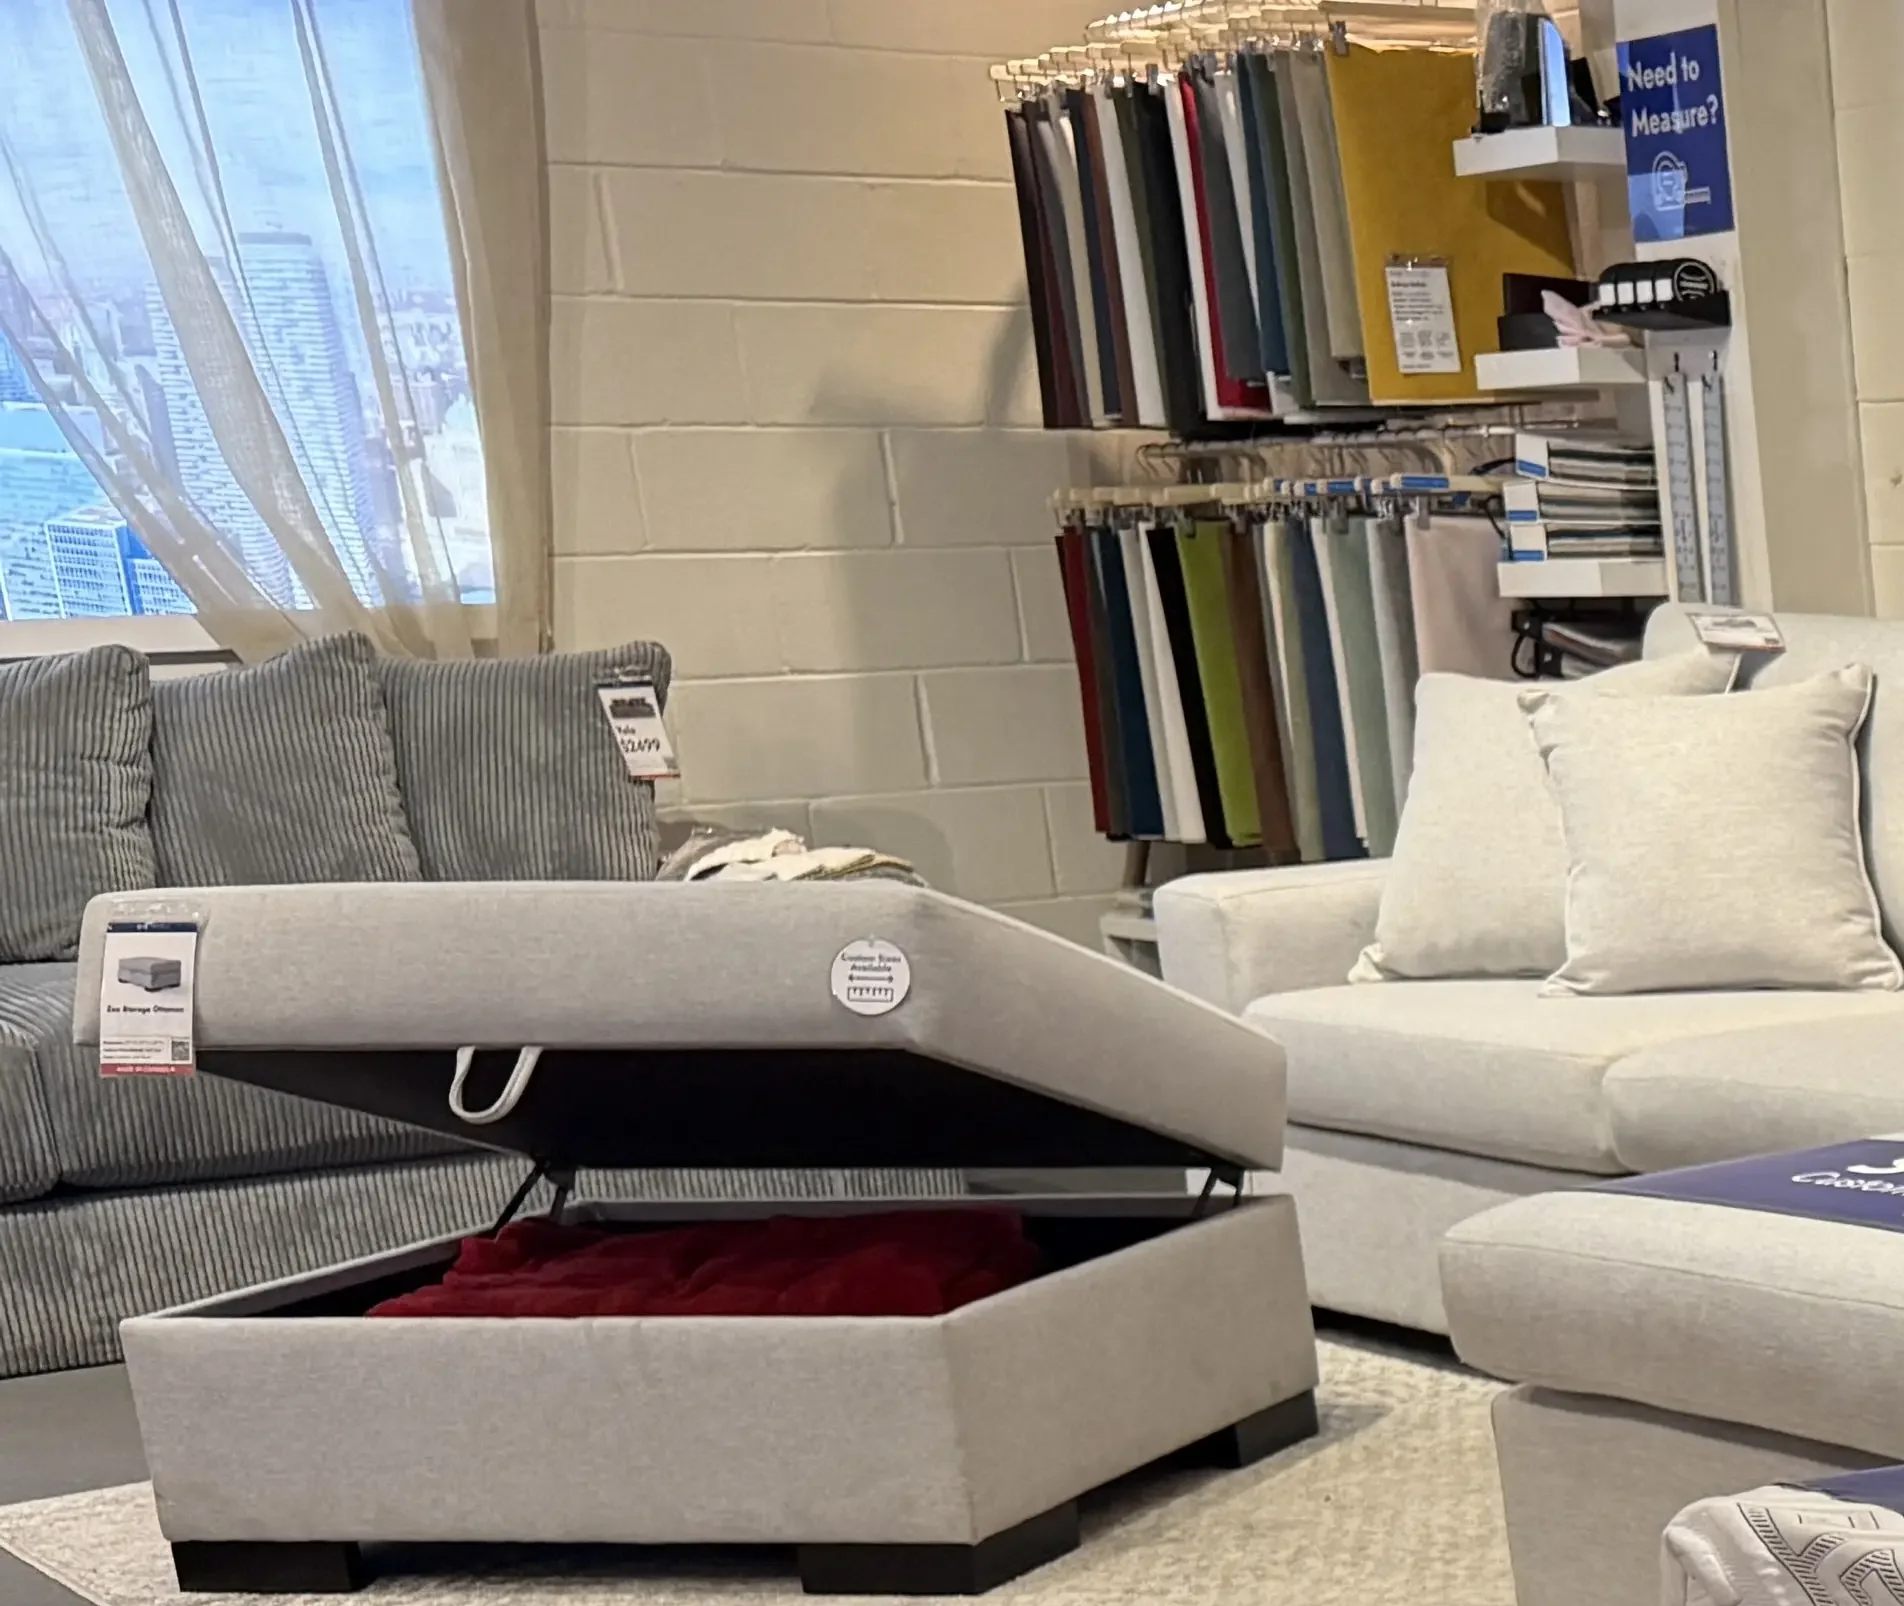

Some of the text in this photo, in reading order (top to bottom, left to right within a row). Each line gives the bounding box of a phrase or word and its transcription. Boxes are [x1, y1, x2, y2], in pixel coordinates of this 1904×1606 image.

[1627, 51, 1700, 92] Need to
[1631, 94, 1720, 138] Measure?
